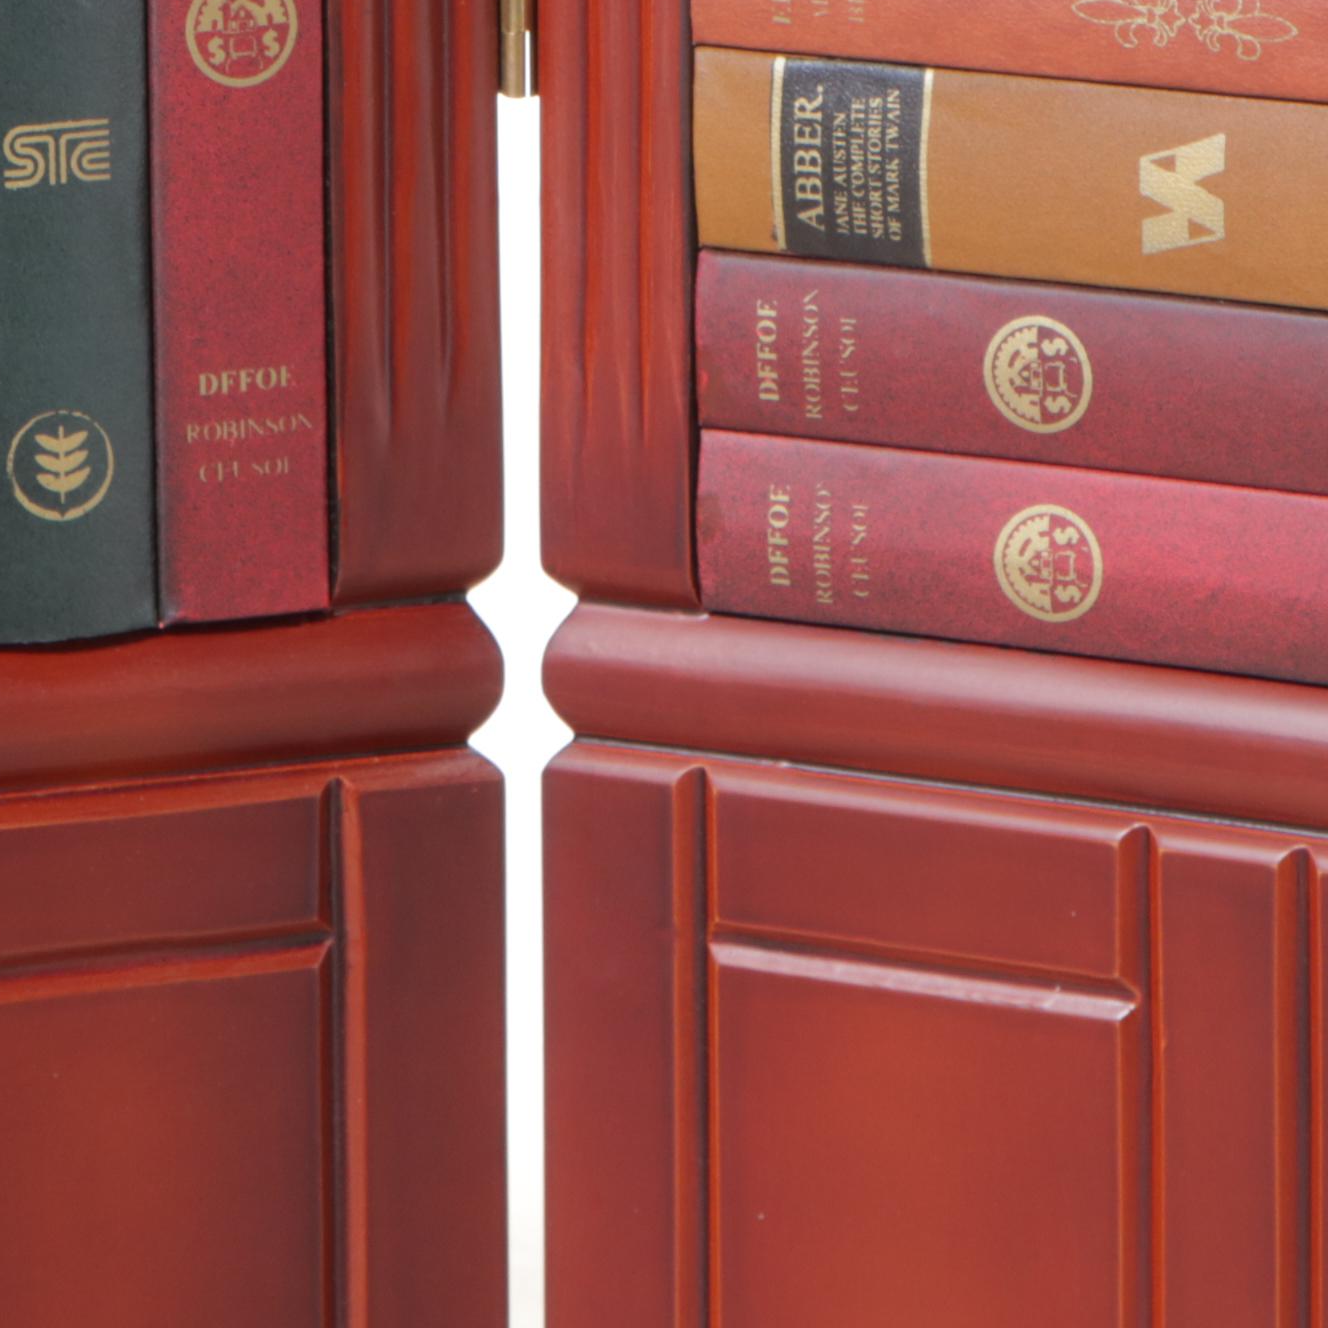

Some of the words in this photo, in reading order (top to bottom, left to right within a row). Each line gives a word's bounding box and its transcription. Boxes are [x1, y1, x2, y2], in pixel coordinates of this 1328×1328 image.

[885, 88, 902, 149] TWAIN
[870, 182, 885, 240] SHORT
[885, 157, 901, 213] MARK
[887, 216, 902, 241] OF
